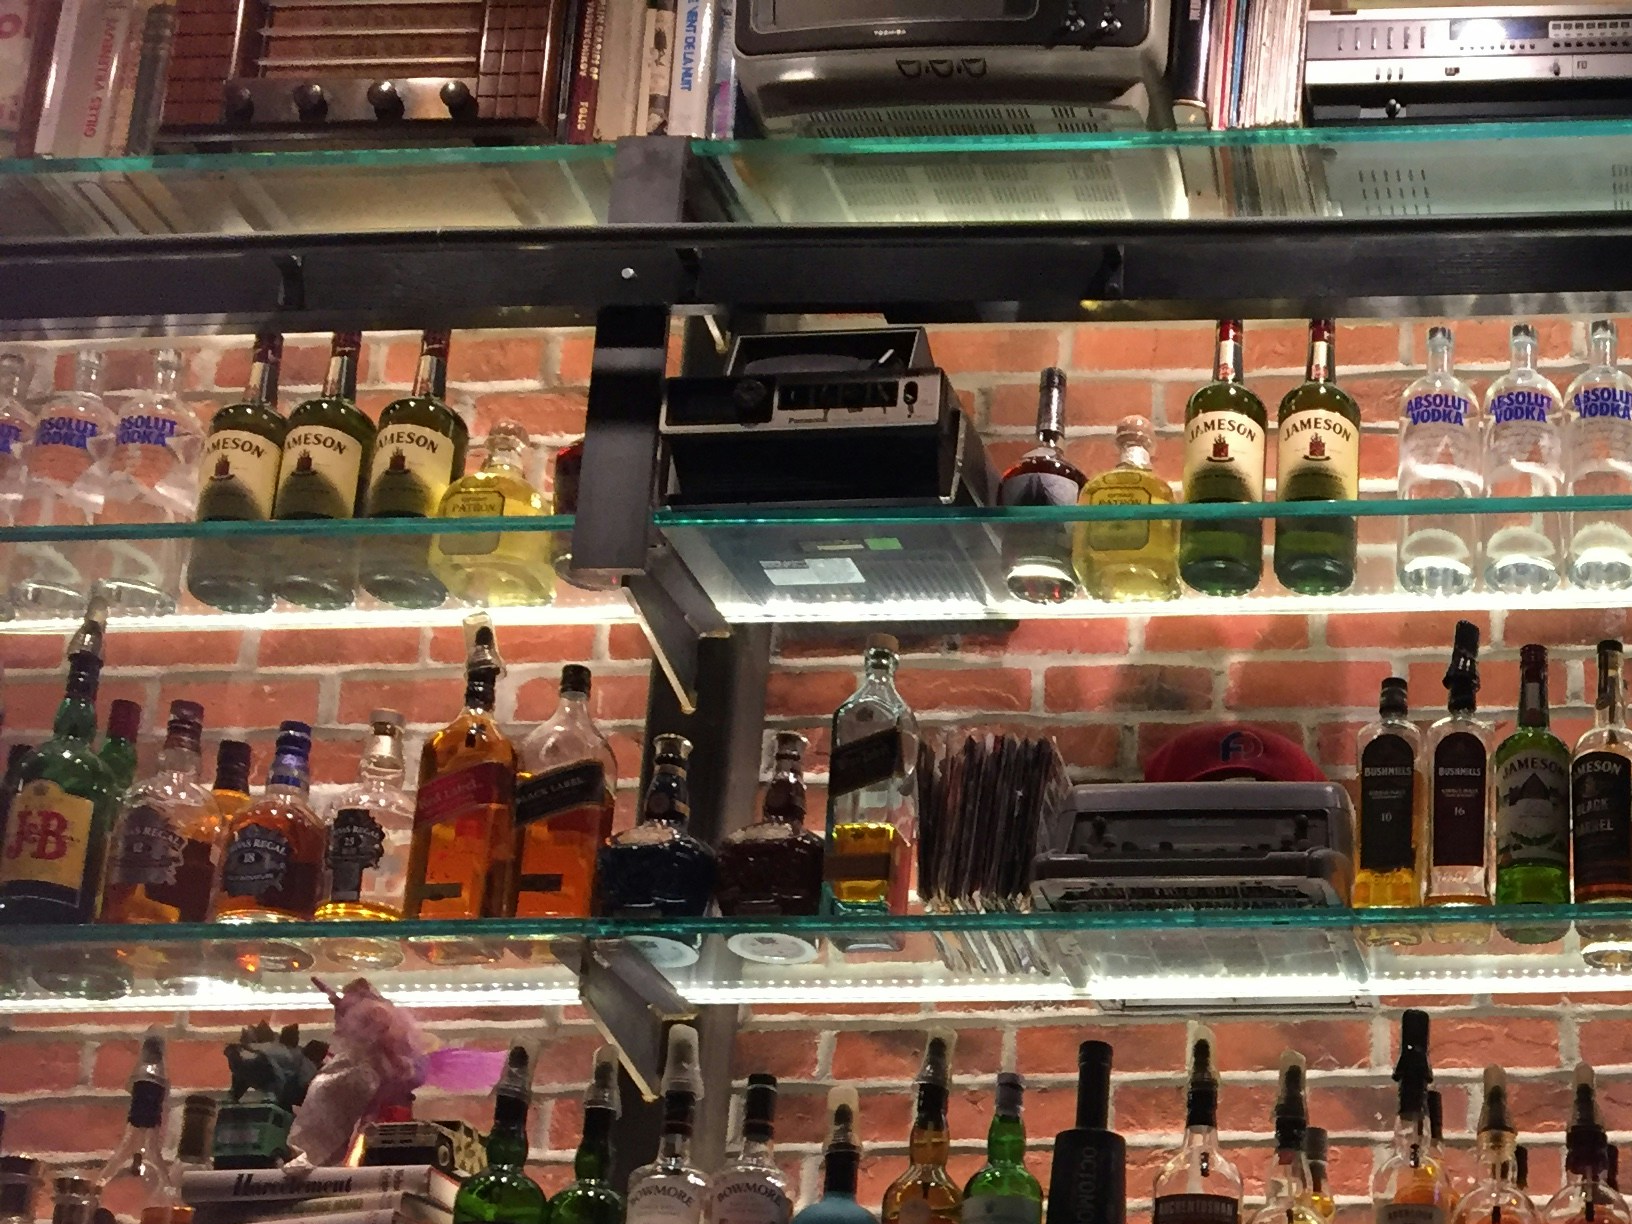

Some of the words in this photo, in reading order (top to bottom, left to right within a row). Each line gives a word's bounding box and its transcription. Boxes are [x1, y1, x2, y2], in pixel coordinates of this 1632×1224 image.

[687, 6, 700, 34] VENT
[681, 66, 692, 91] NUIT
[577, 101, 588, 131] FOLIO
[1406, 393, 1470, 415] ABSOLUT
[1489, 391, 1553, 415] ABSOLUT
[1578, 402, 1632, 422] VODKA
[1411, 409, 1464, 427] VODKA
[1494, 407, 1548, 424] VODKA
[1188, 418, 1257, 443] JAMESON
[1284, 417, 1352, 442] JAMESON
[207, 437, 266, 458] MESON
[286, 432, 348, 455] AMESON
[1364, 767, 1412, 777] BUSHMILLS
[1438, 767, 1481, 777] BUSHMILLS
[1574, 759, 1622, 778] MESON
[1381, 812, 1392, 822] 10
[1454, 806, 1465, 816] 16
[253, 838, 287, 856] REGAL
